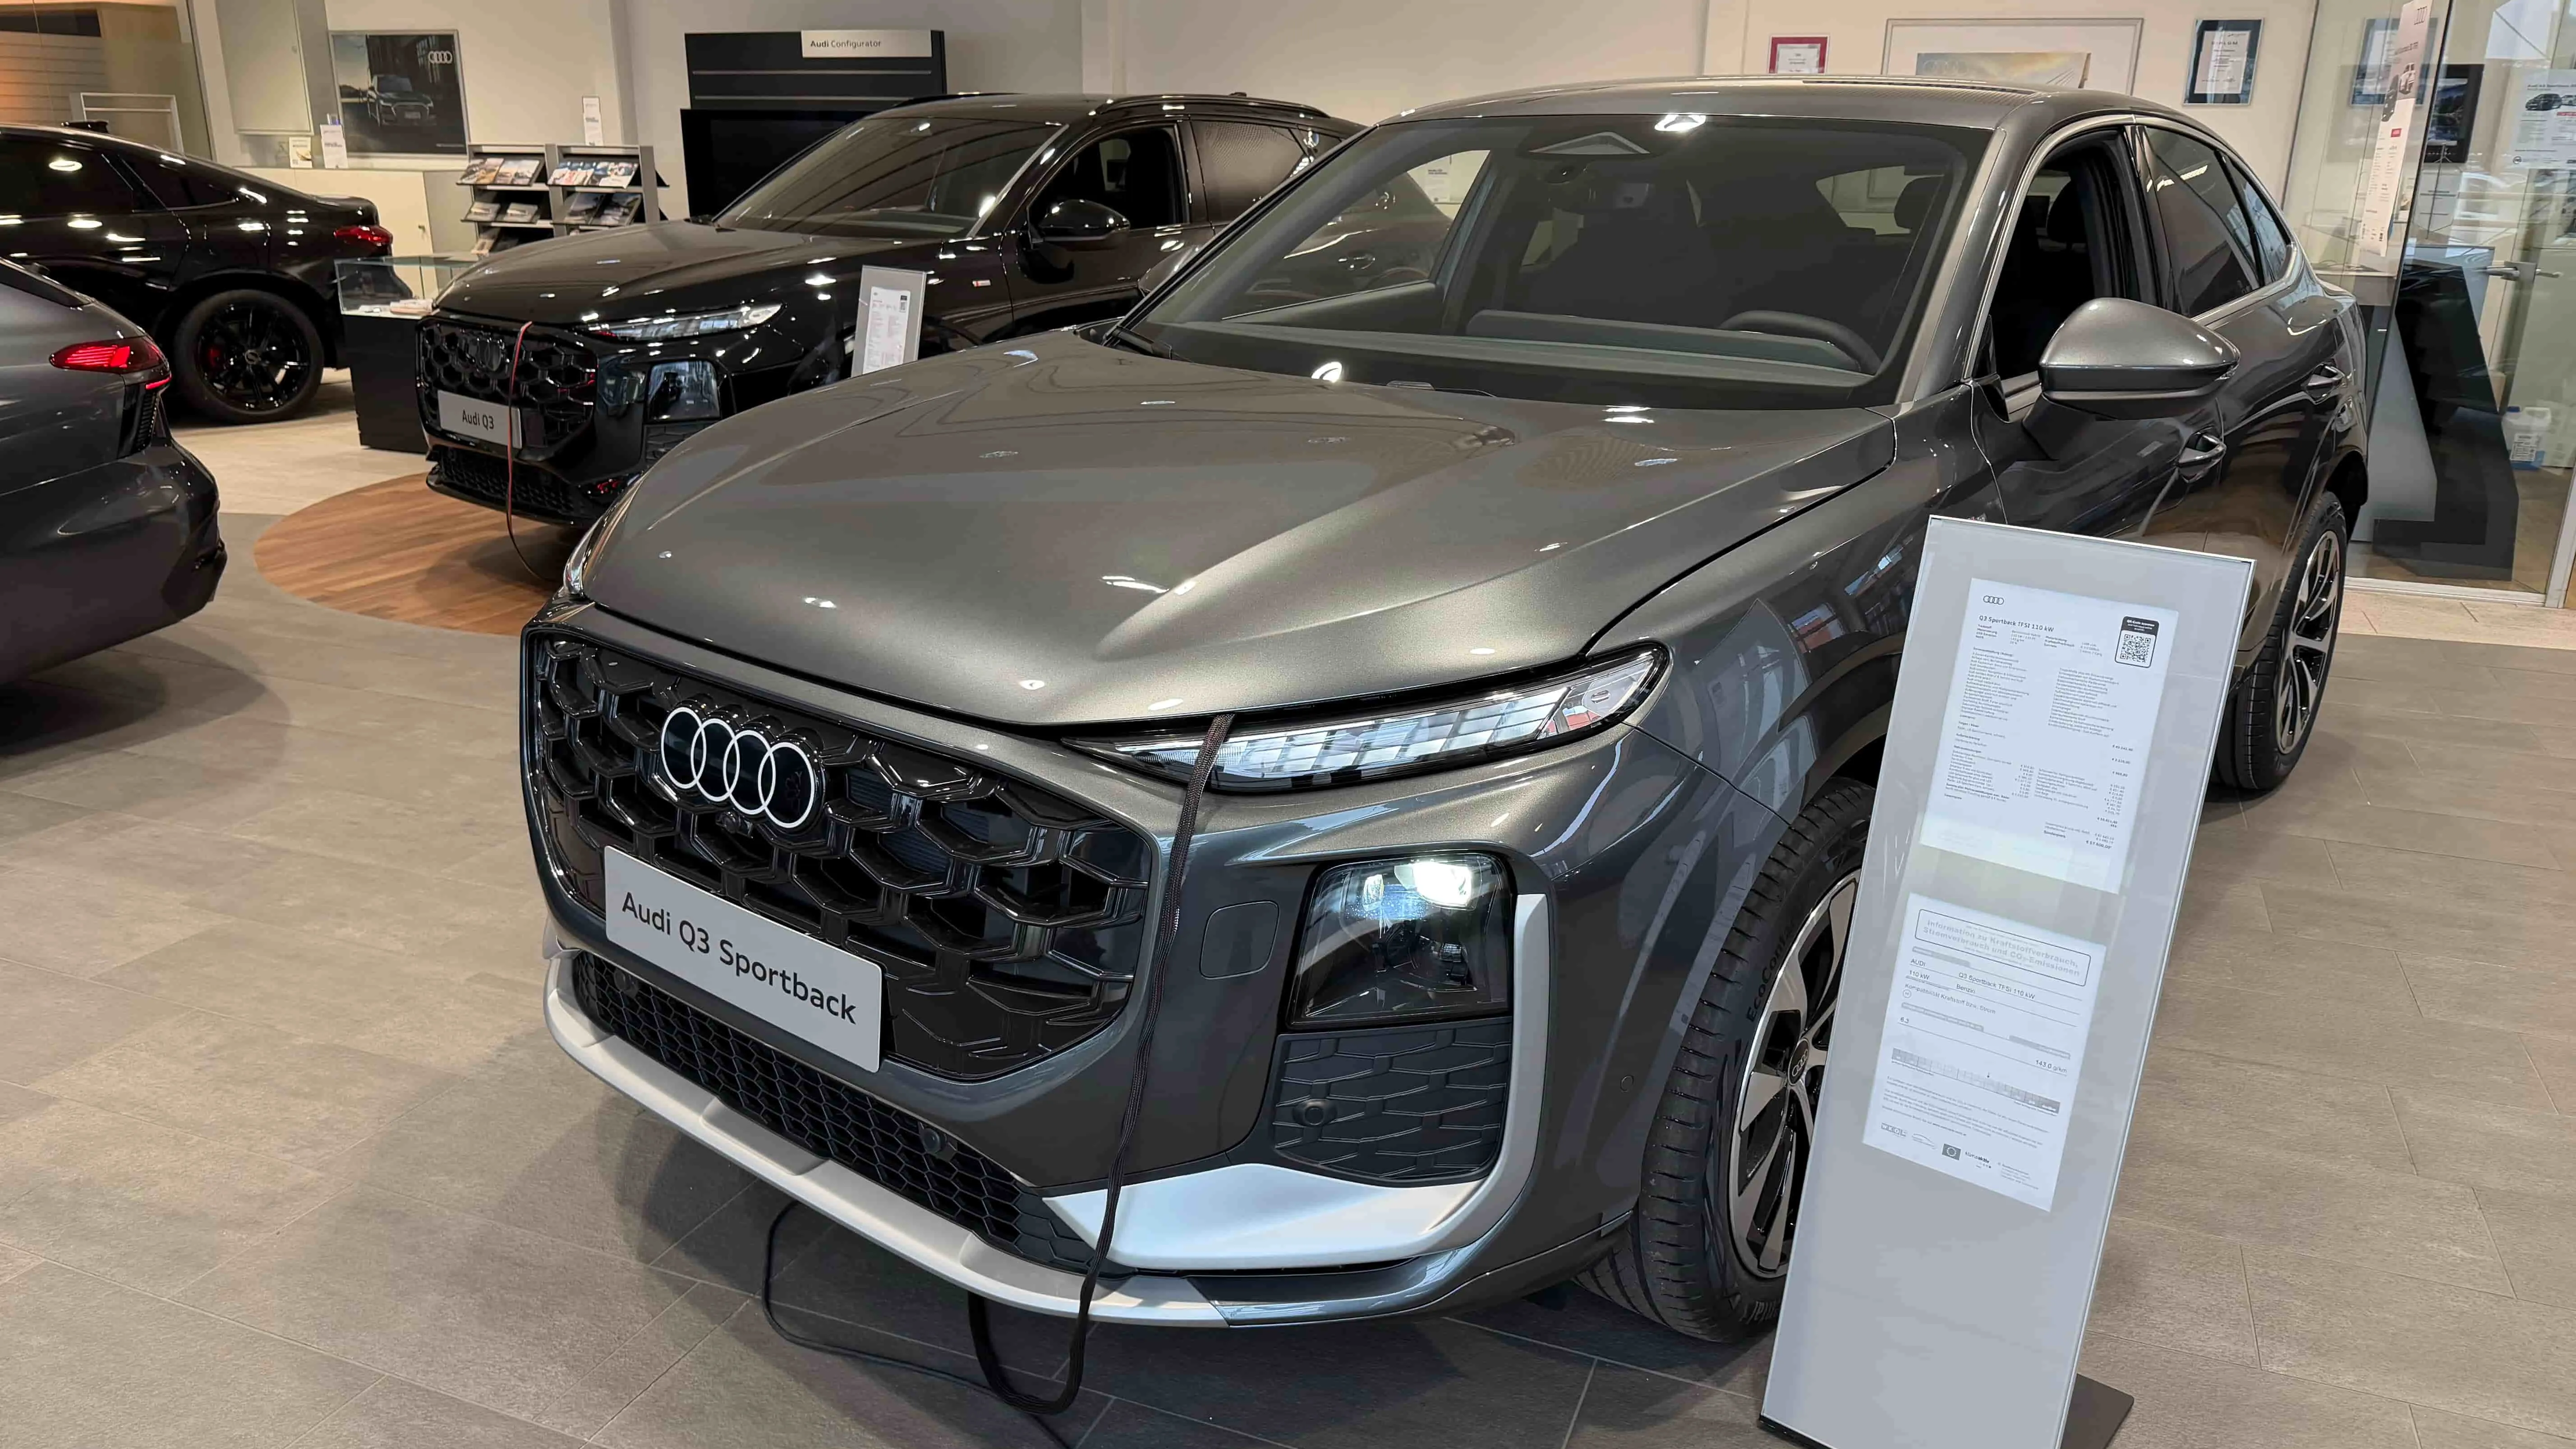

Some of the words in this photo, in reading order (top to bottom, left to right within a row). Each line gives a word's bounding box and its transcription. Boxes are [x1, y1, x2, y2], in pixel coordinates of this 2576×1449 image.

[810, 40, 829, 48] Audi
[831, 40, 881, 49] Configurator
[462, 410, 480, 426] Audi
[482, 415, 494, 430] Q3
[1988, 616, 2017, 626] Sportback
[1927, 920, 1975, 938] Information
[1923, 927, 1989, 950] Stromverbrauch
[1992, 947, 2007, 956] und
[621, 892, 672, 936] Audi
[679, 920, 710, 954] Q3
[720, 939, 856, 1025] Sportback
[1910, 958, 1926, 967] AUDI
[1969, 975, 1996, 988] Sportback
